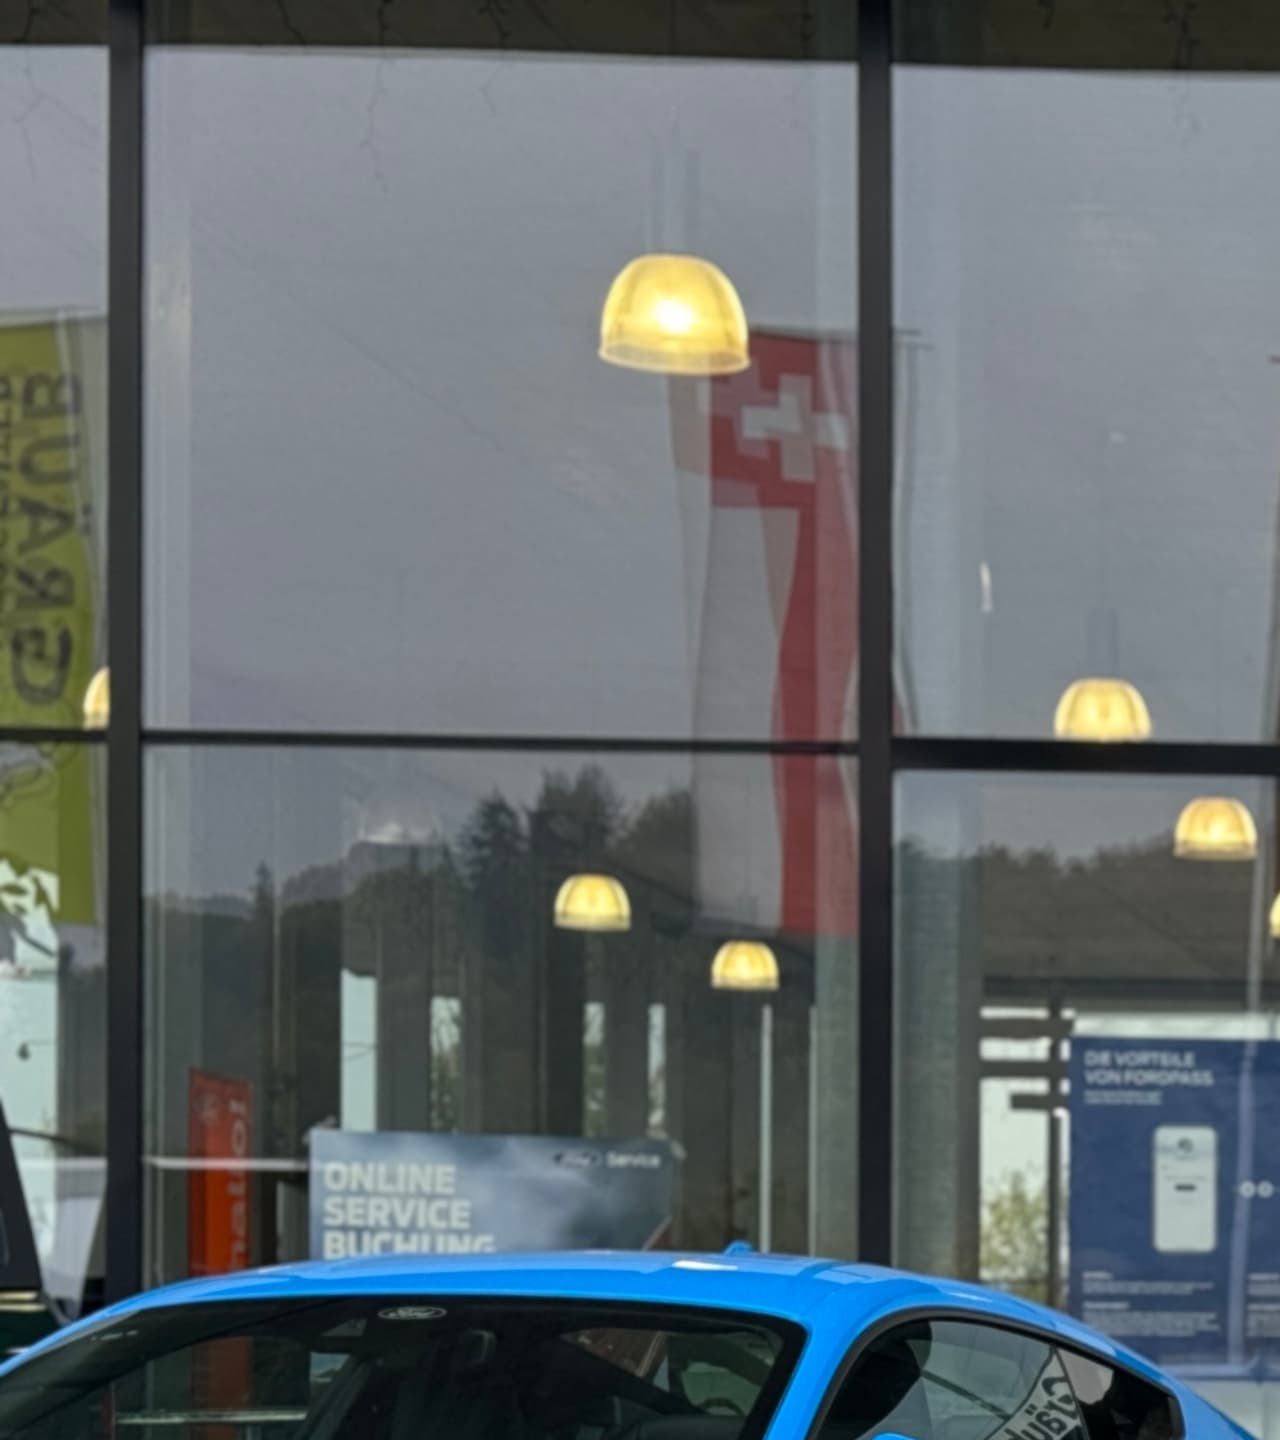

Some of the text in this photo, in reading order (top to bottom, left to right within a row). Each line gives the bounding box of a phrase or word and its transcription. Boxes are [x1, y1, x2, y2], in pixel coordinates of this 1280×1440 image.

[1114, 1050, 1196, 1068] VORTEILE
[1084, 1069, 1121, 1086] VON
[323, 1161, 457, 1195] ONLINE
[323, 1196, 472, 1230] SERVICE
